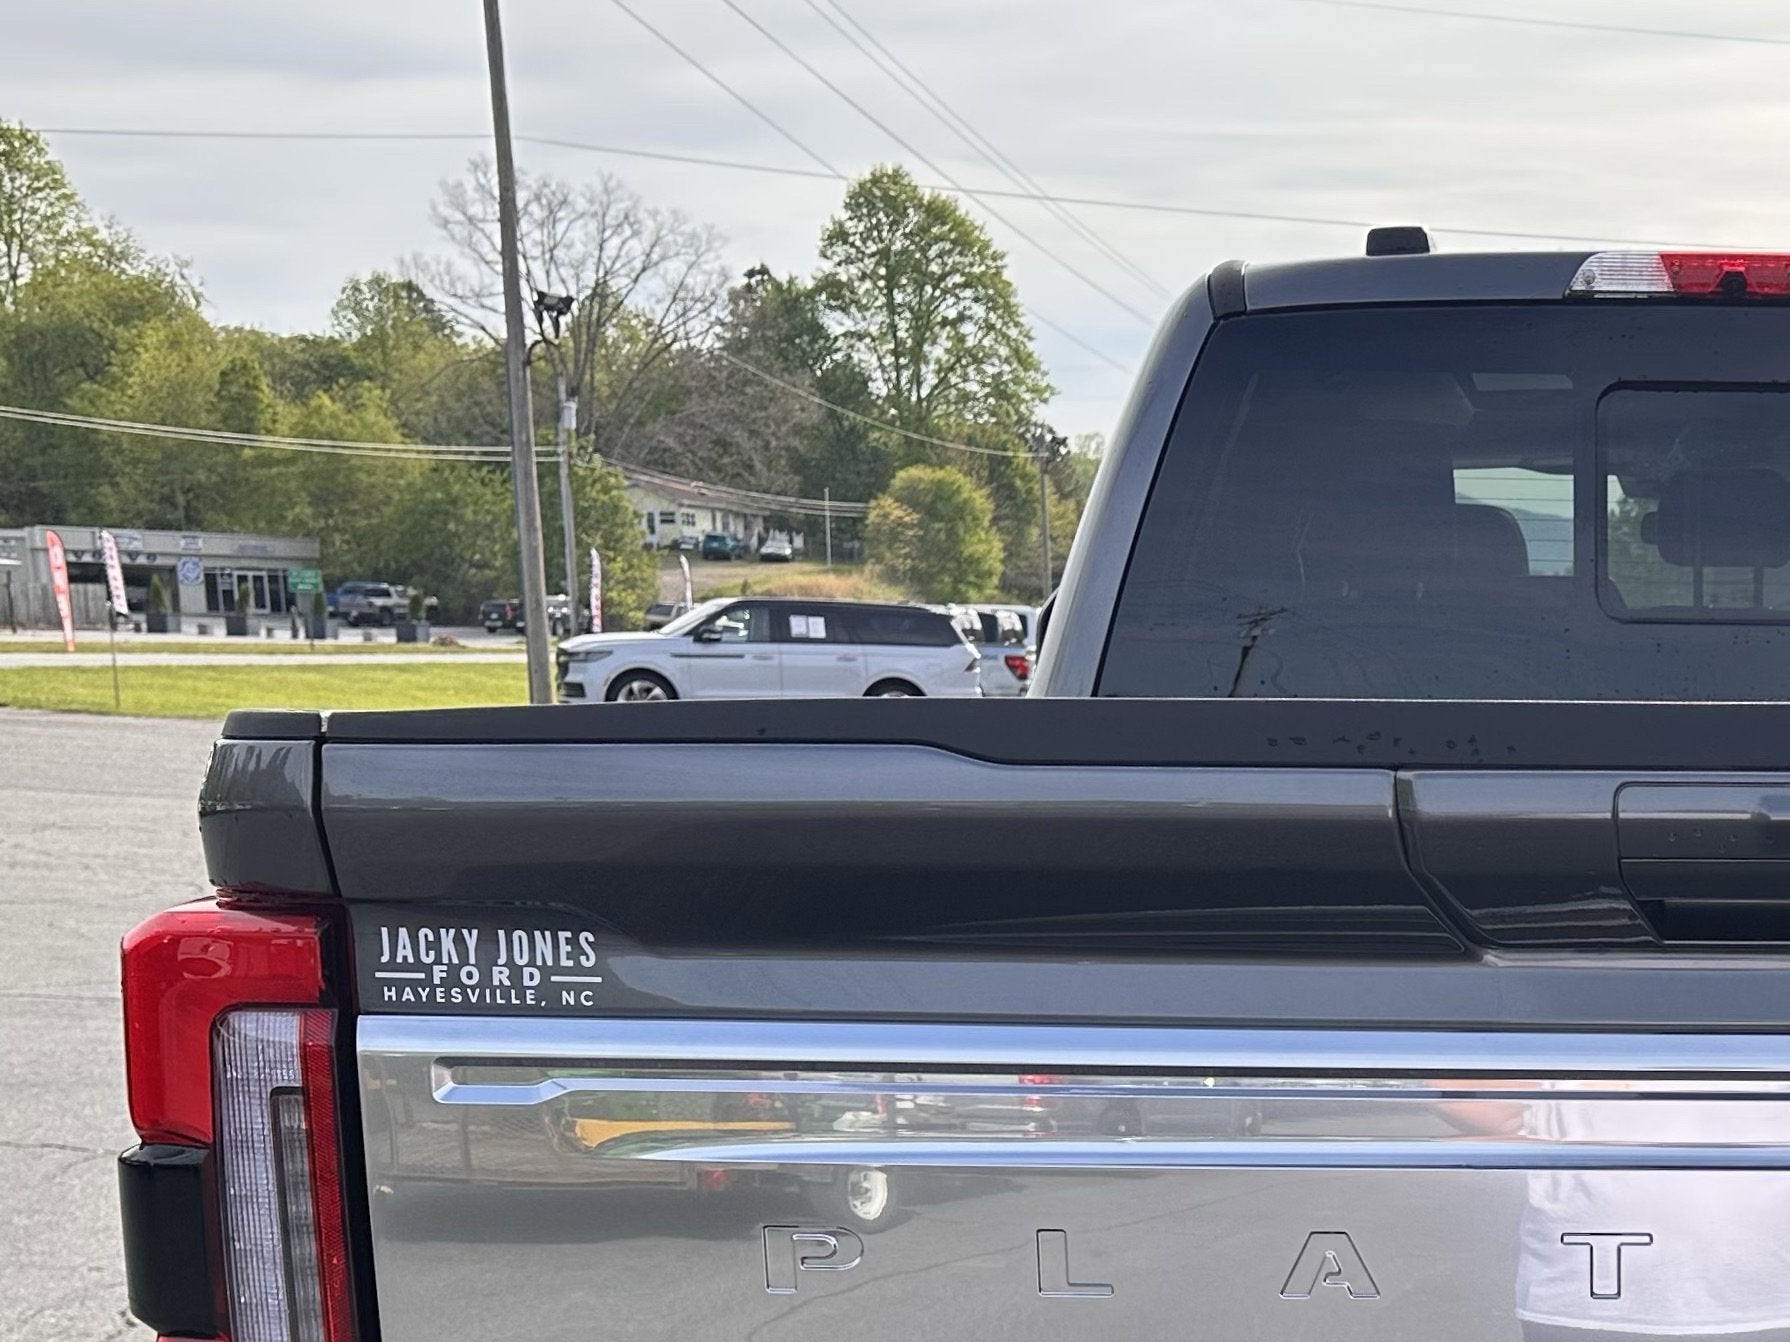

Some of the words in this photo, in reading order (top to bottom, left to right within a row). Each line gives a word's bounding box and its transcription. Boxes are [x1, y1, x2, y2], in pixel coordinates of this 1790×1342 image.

[380, 926, 478, 965] JACKY
[497, 929, 597, 968] JONES
[432, 965, 542, 987] FORD
[383, 986, 546, 1007] HAYESVILLE,
[561, 990, 594, 1006] NC
